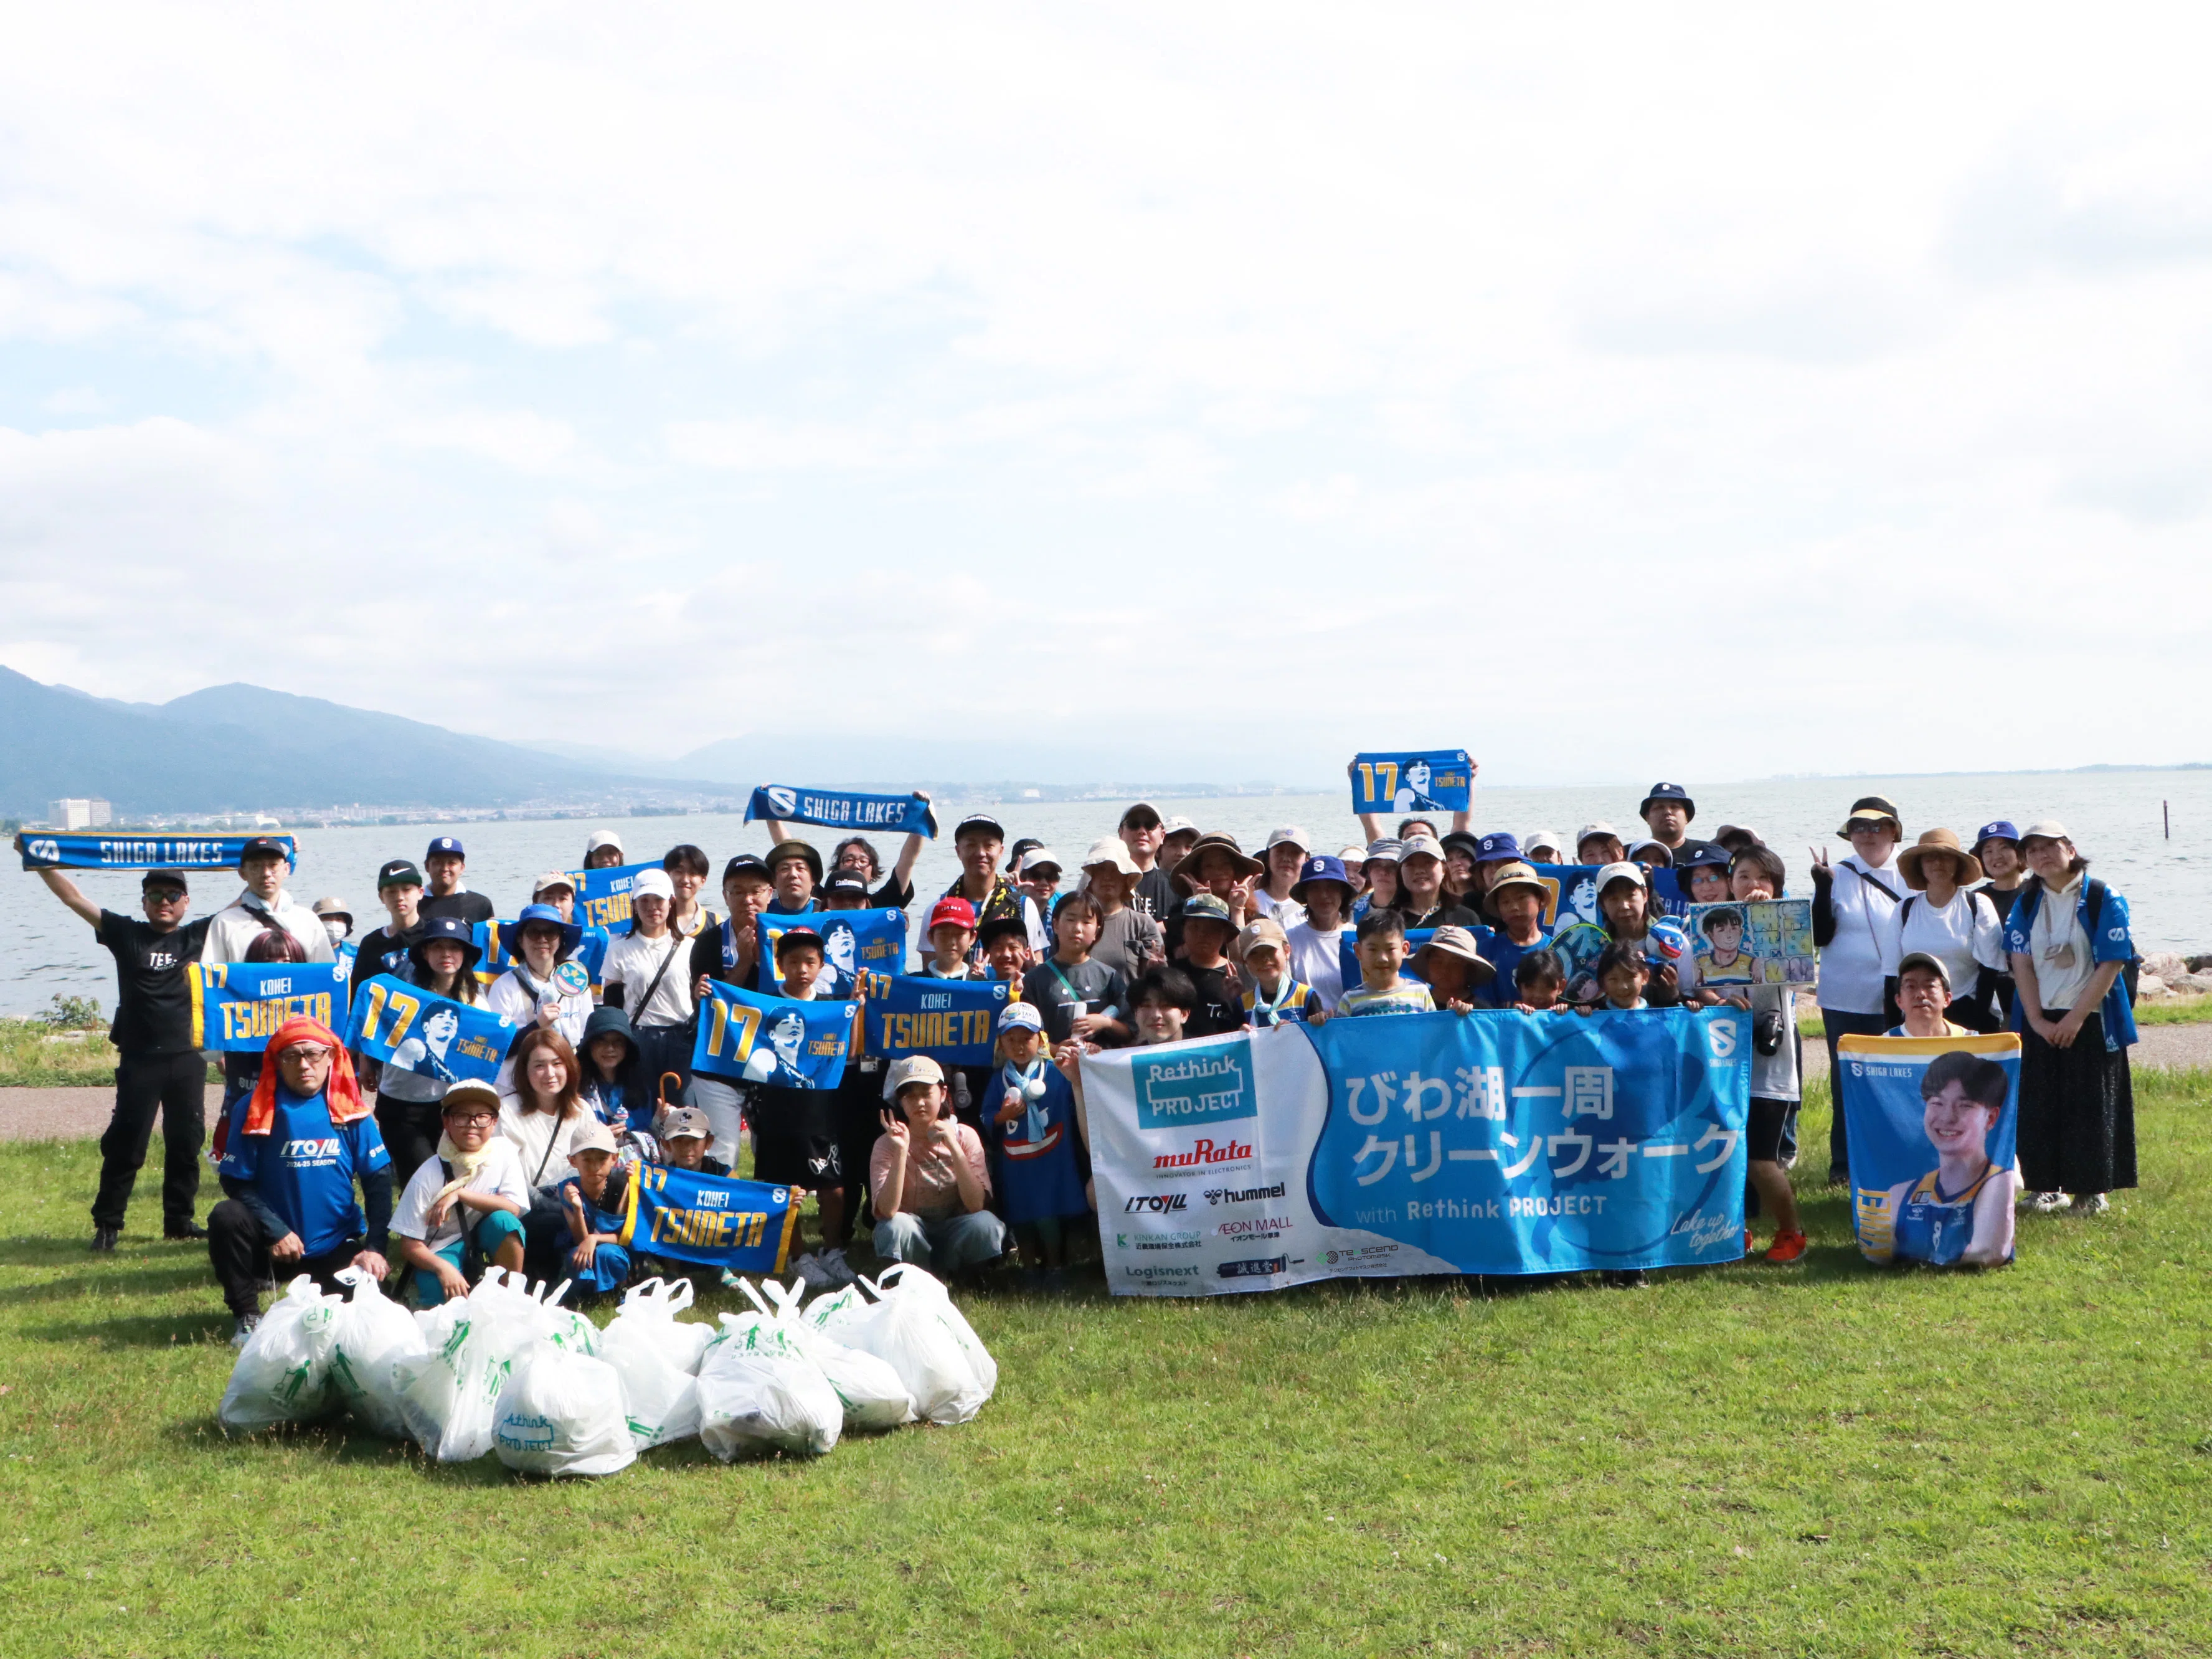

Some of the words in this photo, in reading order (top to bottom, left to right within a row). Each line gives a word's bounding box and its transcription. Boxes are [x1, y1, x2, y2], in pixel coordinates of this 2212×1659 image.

[1358, 762, 1399, 802] 17
[803, 797, 850, 821] SHIGA
[856, 801, 905, 823] LAKES
[100, 841, 156, 864] SHIGA
[164, 842, 224, 863] LAKES
[583, 891, 633, 927] TSUN
[202, 963, 228, 988] 17
[260, 977, 291, 996] KOHEI
[869, 973, 892, 999] 17
[920, 993, 952, 1009] KOHEI
[361, 982, 420, 1048] 17
[707, 998, 762, 1063] 17
[881, 1009, 990, 1049] TSUNETA
[1150, 1055, 1237, 1082] Rethink
[1866, 1066, 1888, 1076] SHIGA
[1889, 1066, 1912, 1077] LAKES
[1152, 1091, 1241, 1117] PROJECT
[1345, 1066, 1613, 1125] びわ湖一周
[1153, 1138, 1252, 1168] muRata
[1352, 1123, 1739, 1187] クリーンウォーク
[643, 1164, 668, 1193] 17
[1156, 1171, 1196, 1179] INNOVATOR
[1208, 1164, 1251, 1175] ELECTRONICS
[696, 1189, 730, 1208] KOHEI
[1224, 1182, 1285, 1203] hummel
[1356, 1206, 1397, 1224] with
[1407, 1198, 1500, 1221] Rethink
[1509, 1196, 1607, 1217] PROJECT
[1670, 1209, 1706, 1236] Lake
[1707, 1213, 1724, 1229] up
[650, 1206, 767, 1247] TSUNETA
[1134, 1233, 1168, 1241] KINKAN
[1170, 1231, 1201, 1241] GROUP
[1255, 1216, 1293, 1231] MALL
[1690, 1219, 1739, 1255] together
[1125, 1265, 1199, 1279] Logisnext
[499, 1435, 552, 1452] PROJECT
